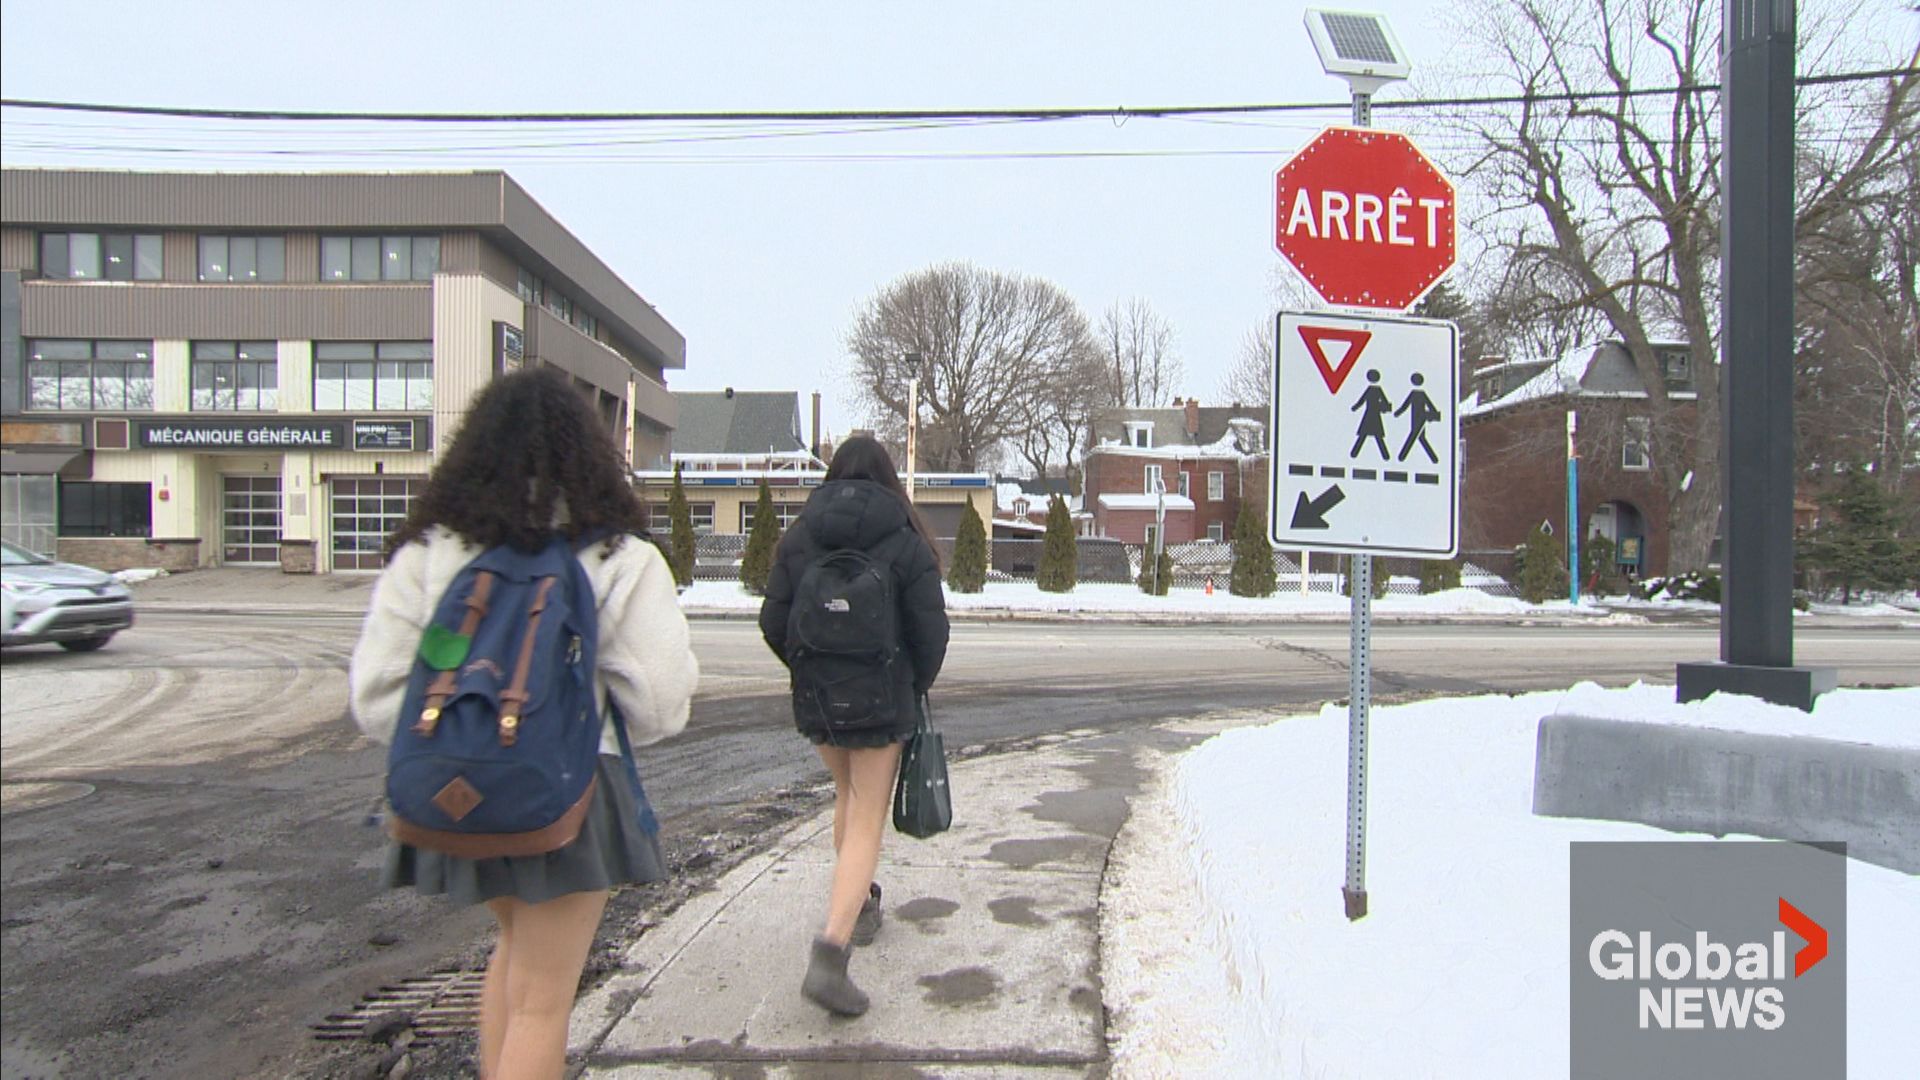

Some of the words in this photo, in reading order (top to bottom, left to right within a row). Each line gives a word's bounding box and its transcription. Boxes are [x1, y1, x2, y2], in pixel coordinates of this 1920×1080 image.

[1286, 187, 1445, 248] ARRÊT
[149, 426, 244, 444] MÉCANIQUE
[247, 426, 332, 444] GÉNÉRALE
